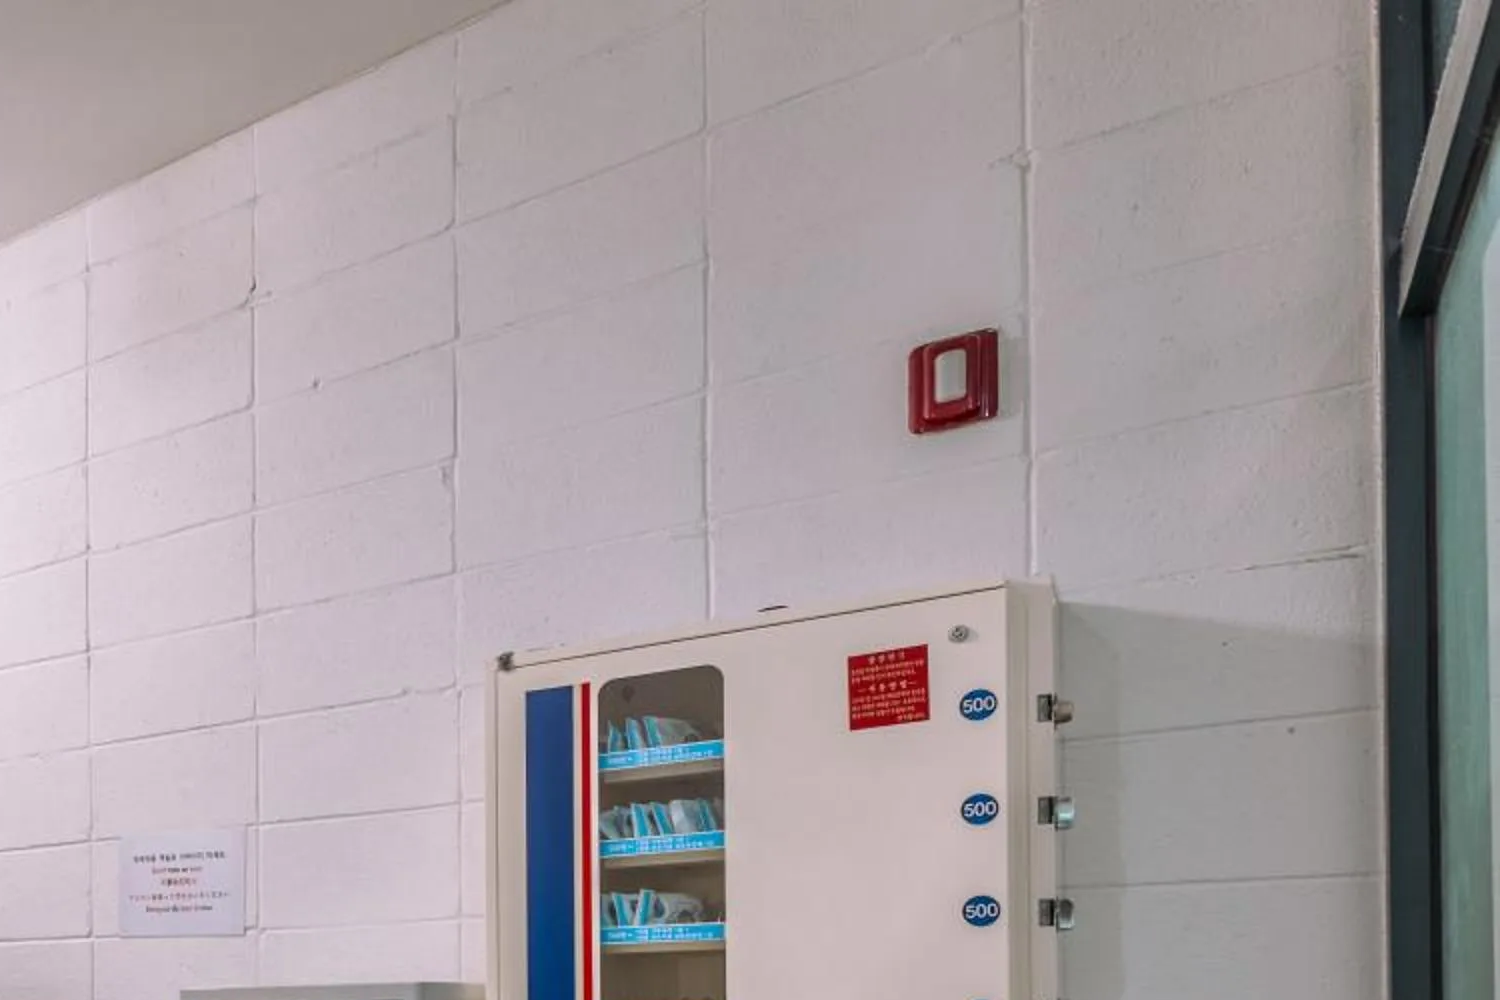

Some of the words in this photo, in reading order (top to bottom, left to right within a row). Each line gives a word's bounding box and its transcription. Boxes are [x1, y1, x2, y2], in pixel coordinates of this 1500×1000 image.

[963, 697, 996, 714] 500
[964, 801, 997, 817] 500
[965, 903, 998, 919] 500
